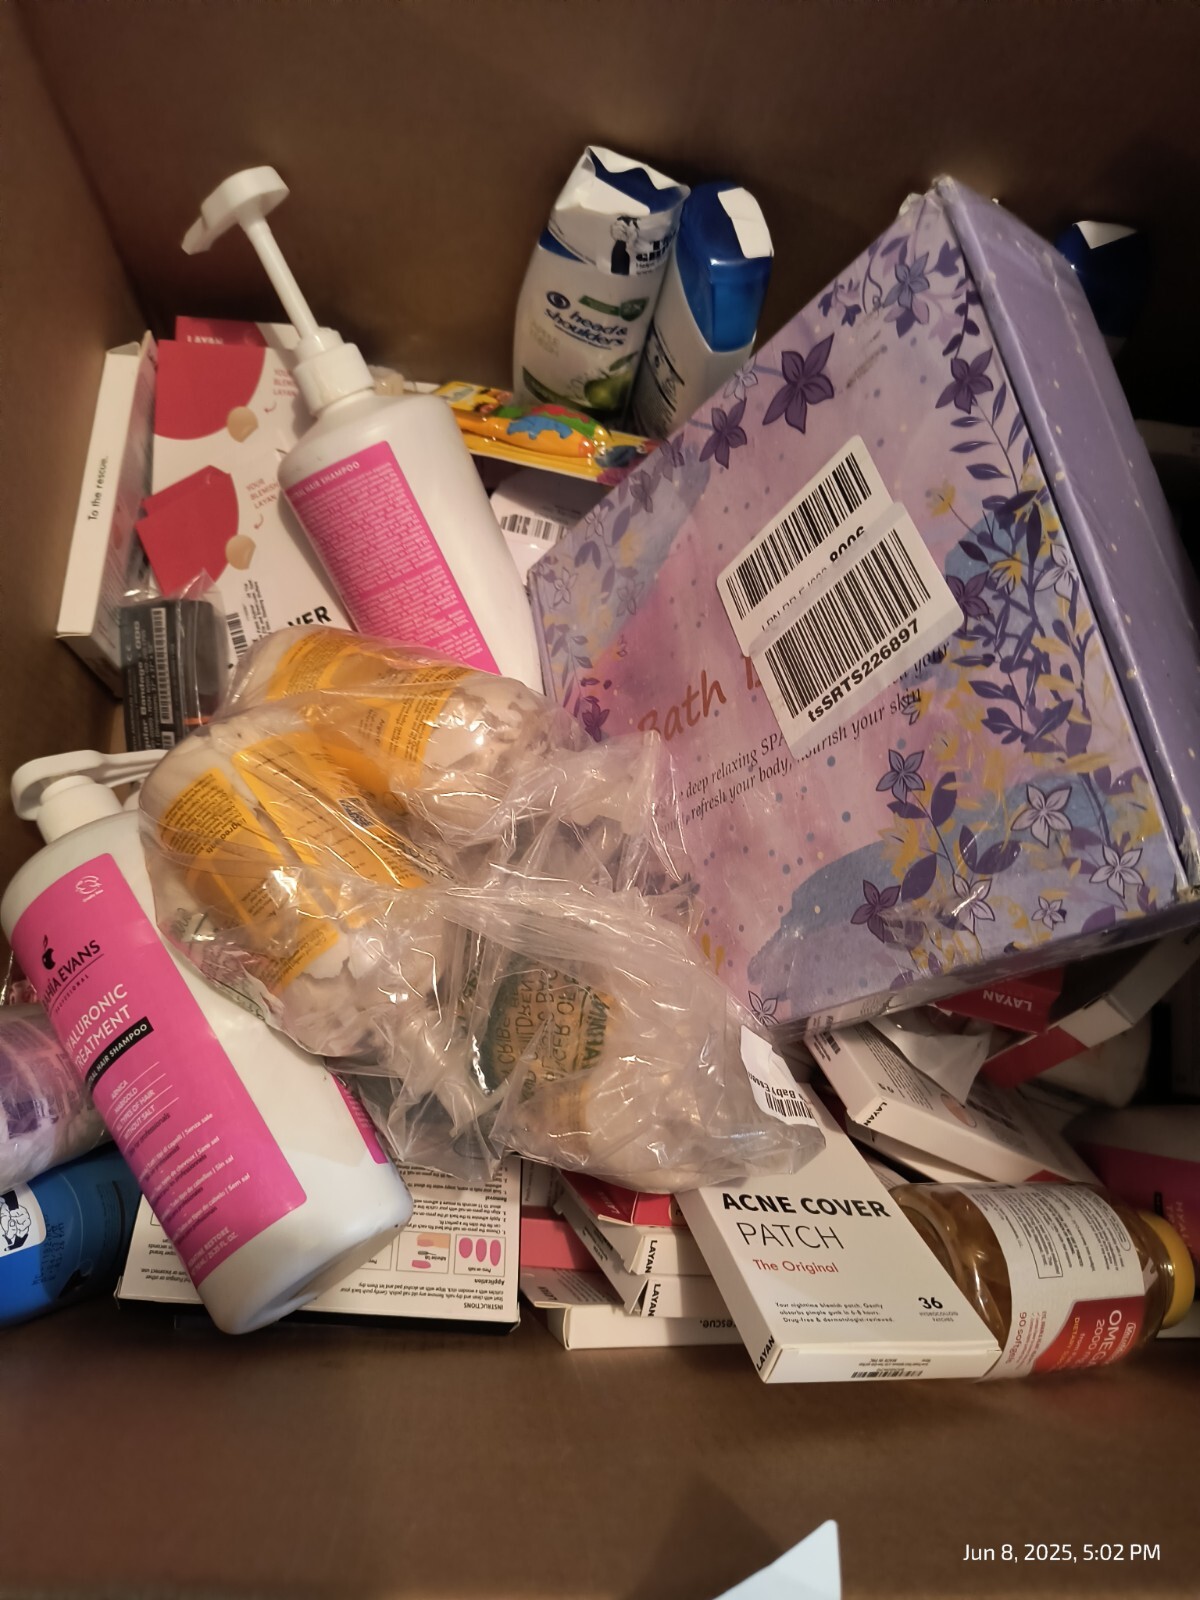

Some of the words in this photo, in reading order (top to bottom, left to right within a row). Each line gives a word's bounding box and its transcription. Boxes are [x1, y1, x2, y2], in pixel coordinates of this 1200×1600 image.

[95, 455, 108, 488] rescue.
[90, 491, 102, 507] the
[87, 509, 99, 521] To
[806, 618, 919, 722] tsSRTS226897
[135, 661, 147, 715] Bandage
[683, 775, 710, 798] deep
[709, 747, 758, 783] relaxing
[688, 791, 728, 820] refresh
[728, 776, 757, 803] your
[756, 755, 794, 782] body,
[849, 706, 888, 741] your
[57, 939, 100, 981] EVANS
[981, 989, 1033, 1011] LAYAN
[75, 1004, 131, 1072] TREATMENT
[96, 1056, 110, 1071] HAIR
[109, 1023, 148, 1057] SHAMPOO
[139, 1090, 155, 1106] HAIR
[771, 1086, 795, 1098] Baby
[141, 1105, 156, 1123] SALT
[184, 1119, 202, 1135] Senza
[199, 1112, 214, 1124] sale
[863, 1100, 887, 1127] LAYAN
[226, 1178, 241, 1191] Sem
[721, 1192, 797, 1213] ACNE
[799, 1196, 892, 1218] COVER
[735, 1221, 845, 1250] PATCH
[645, 1239, 658, 1274] LAYAN
[752, 1258, 778, 1271] The
[781, 1259, 839, 1275] Original
[648, 1283, 661, 1317] LAYAN
[917, 1296, 943, 1309] 36
[782, 1315, 814, 1324] Drug-free
[1017, 1311, 1027, 1327] 90
[1005, 1329, 1023, 1363] softgels
[1088, 1319, 1104, 1349] 2000
[754, 1334, 777, 1371] LAYAN
